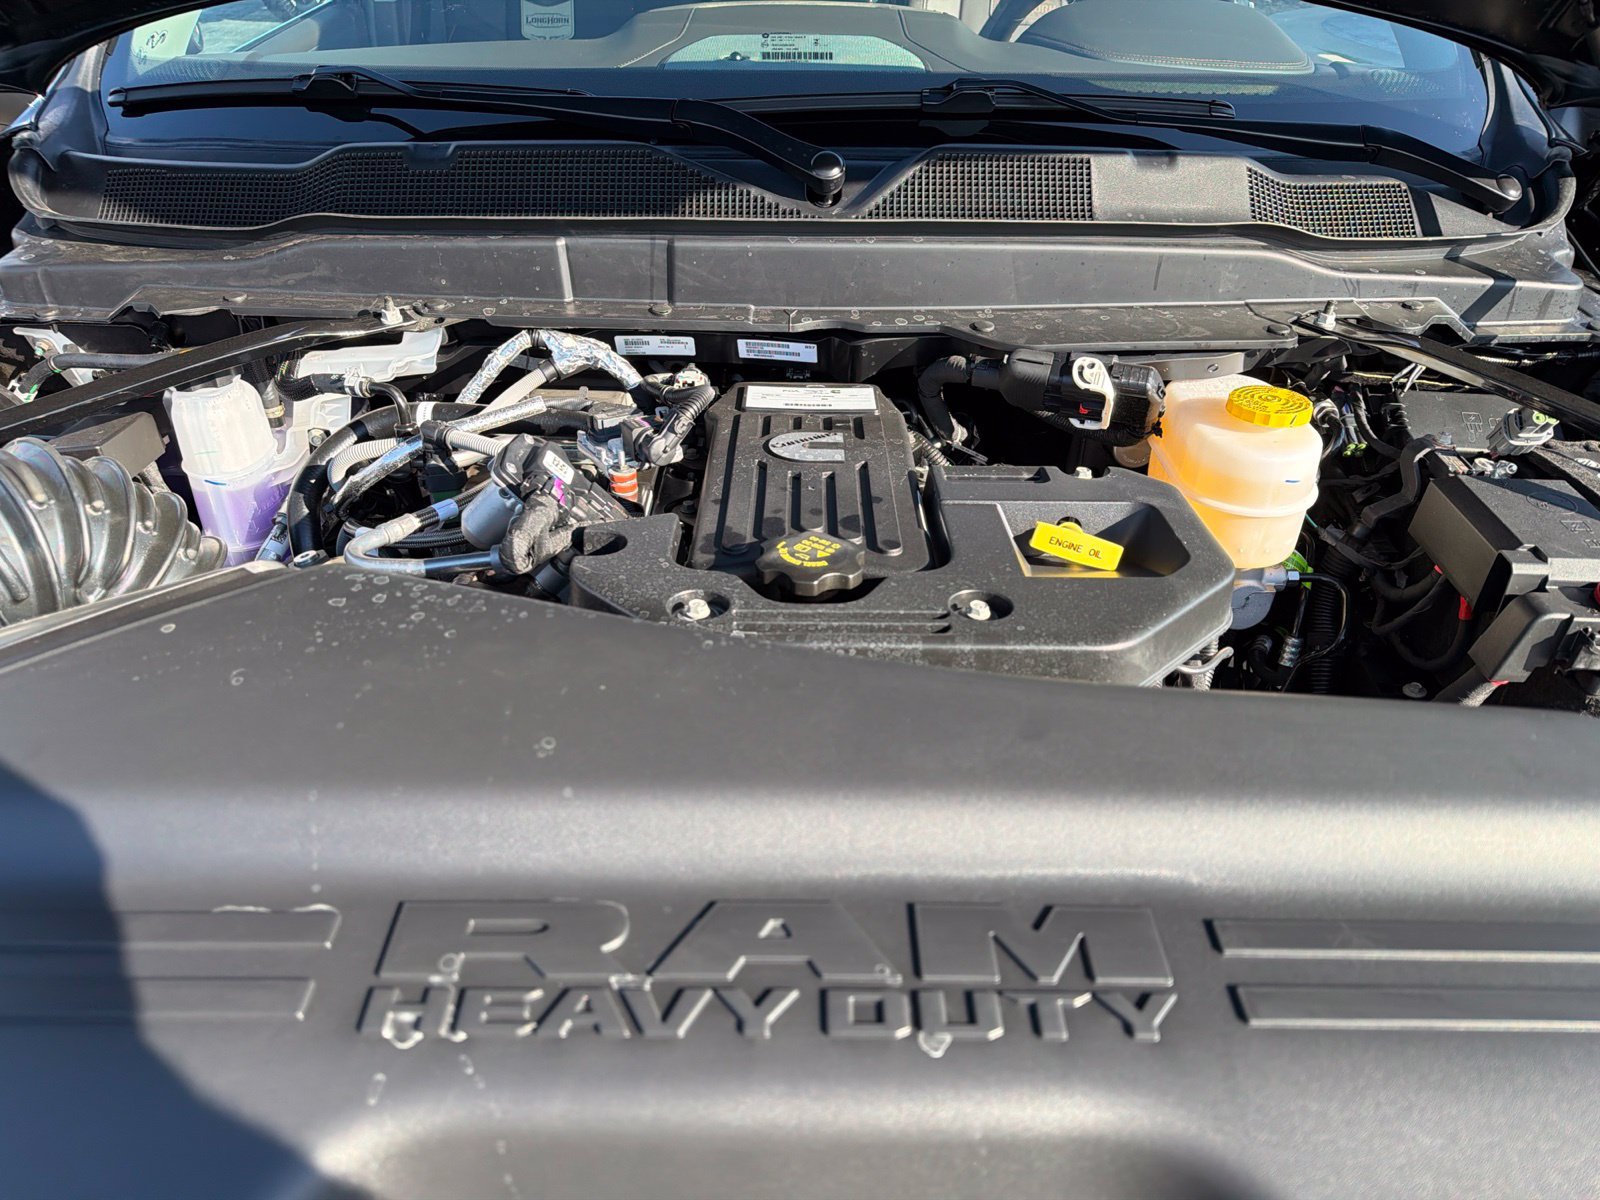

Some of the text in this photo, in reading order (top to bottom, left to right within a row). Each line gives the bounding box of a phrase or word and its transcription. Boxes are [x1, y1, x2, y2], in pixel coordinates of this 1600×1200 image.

[770, 432, 837, 448] Cummins
[1048, 536, 1102, 559] ENGINE OIL
[375, 898, 1174, 985] RAM
[356, 986, 1178, 1042] HEAVY DUTY
